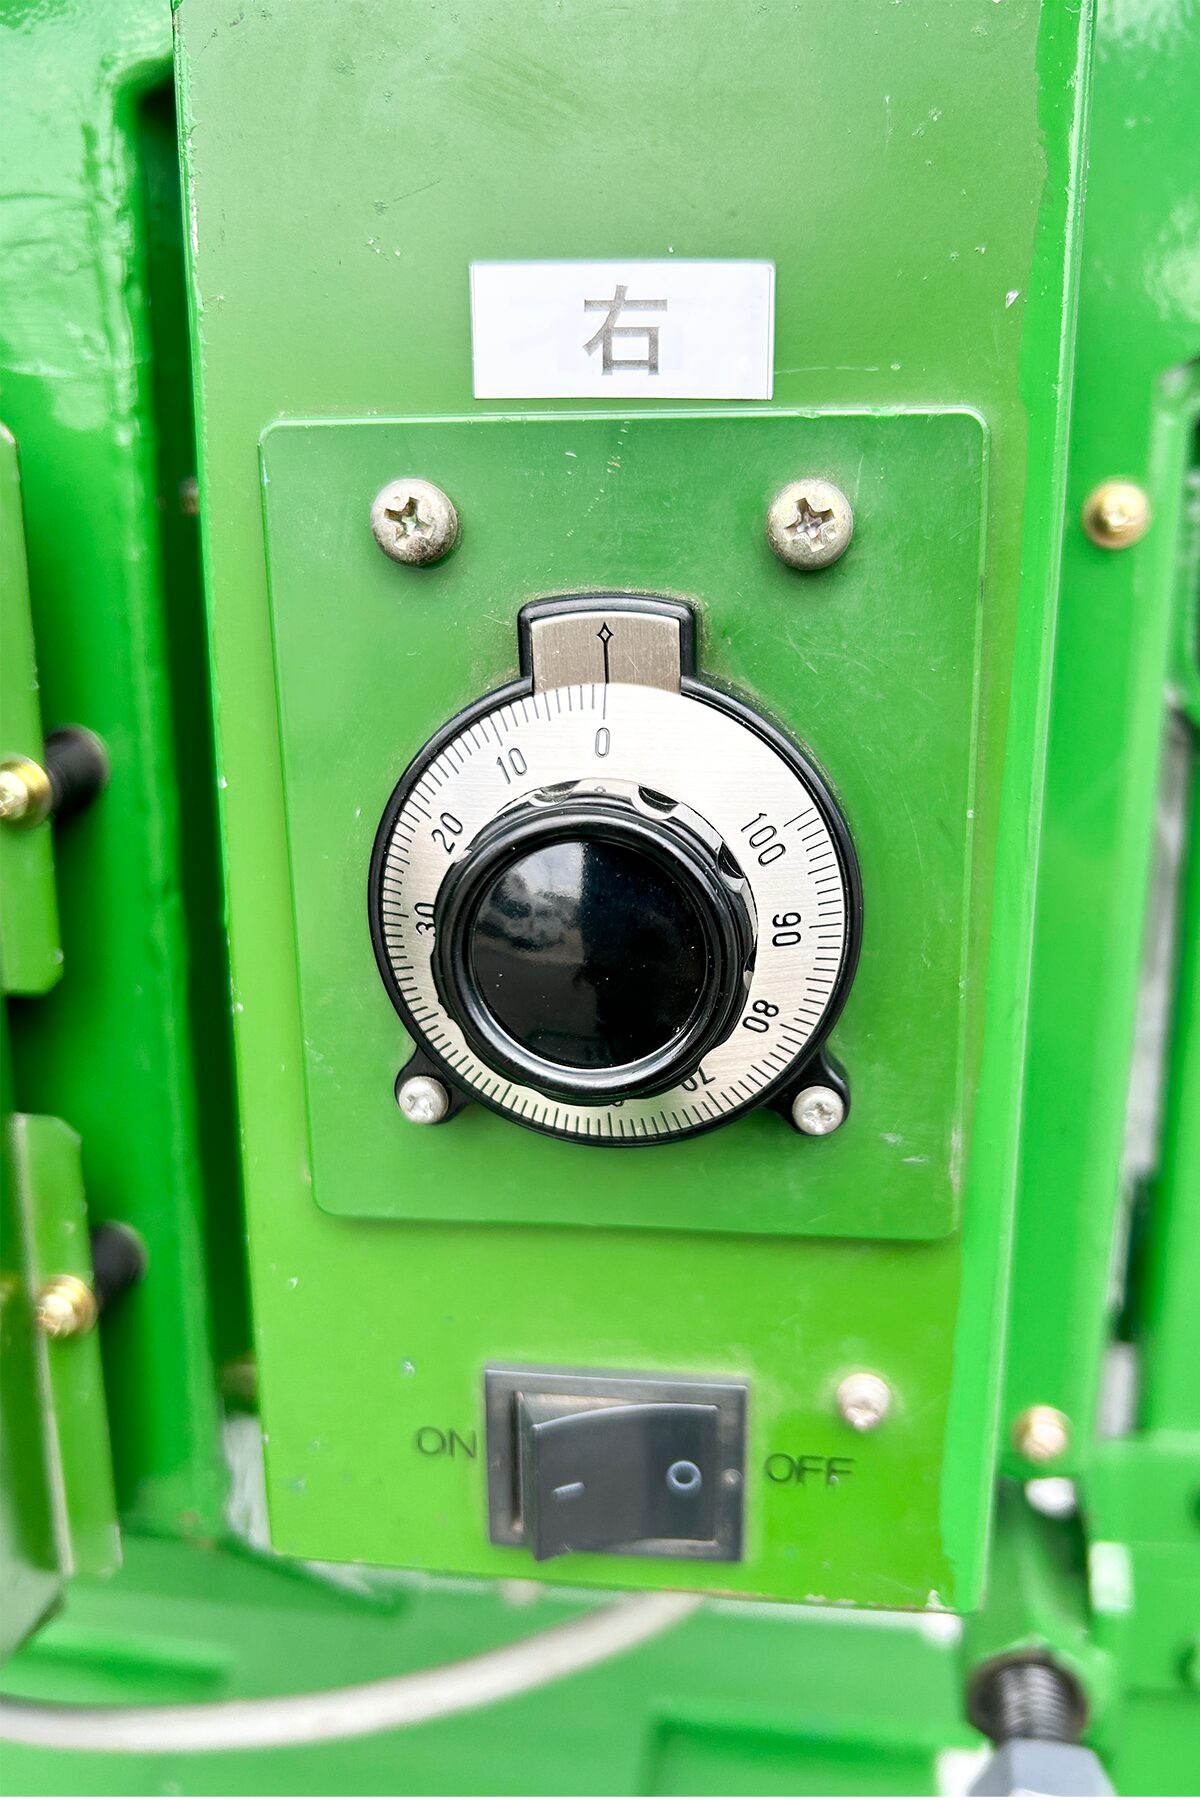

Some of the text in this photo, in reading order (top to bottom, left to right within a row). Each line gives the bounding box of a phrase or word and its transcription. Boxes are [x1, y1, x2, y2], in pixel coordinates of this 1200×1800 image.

[582, 284, 668, 376] 右
[594, 727, 611, 758] 0
[496, 747, 528, 784] 10
[431, 812, 463, 854] 20
[741, 812, 786, 867] 100
[414, 902, 436, 937] 30
[772, 911, 801, 947] 90
[742, 1000, 779, 1033] 80
[416, 1426, 477, 1459] ON
[764, 1452, 856, 1487] OFF
